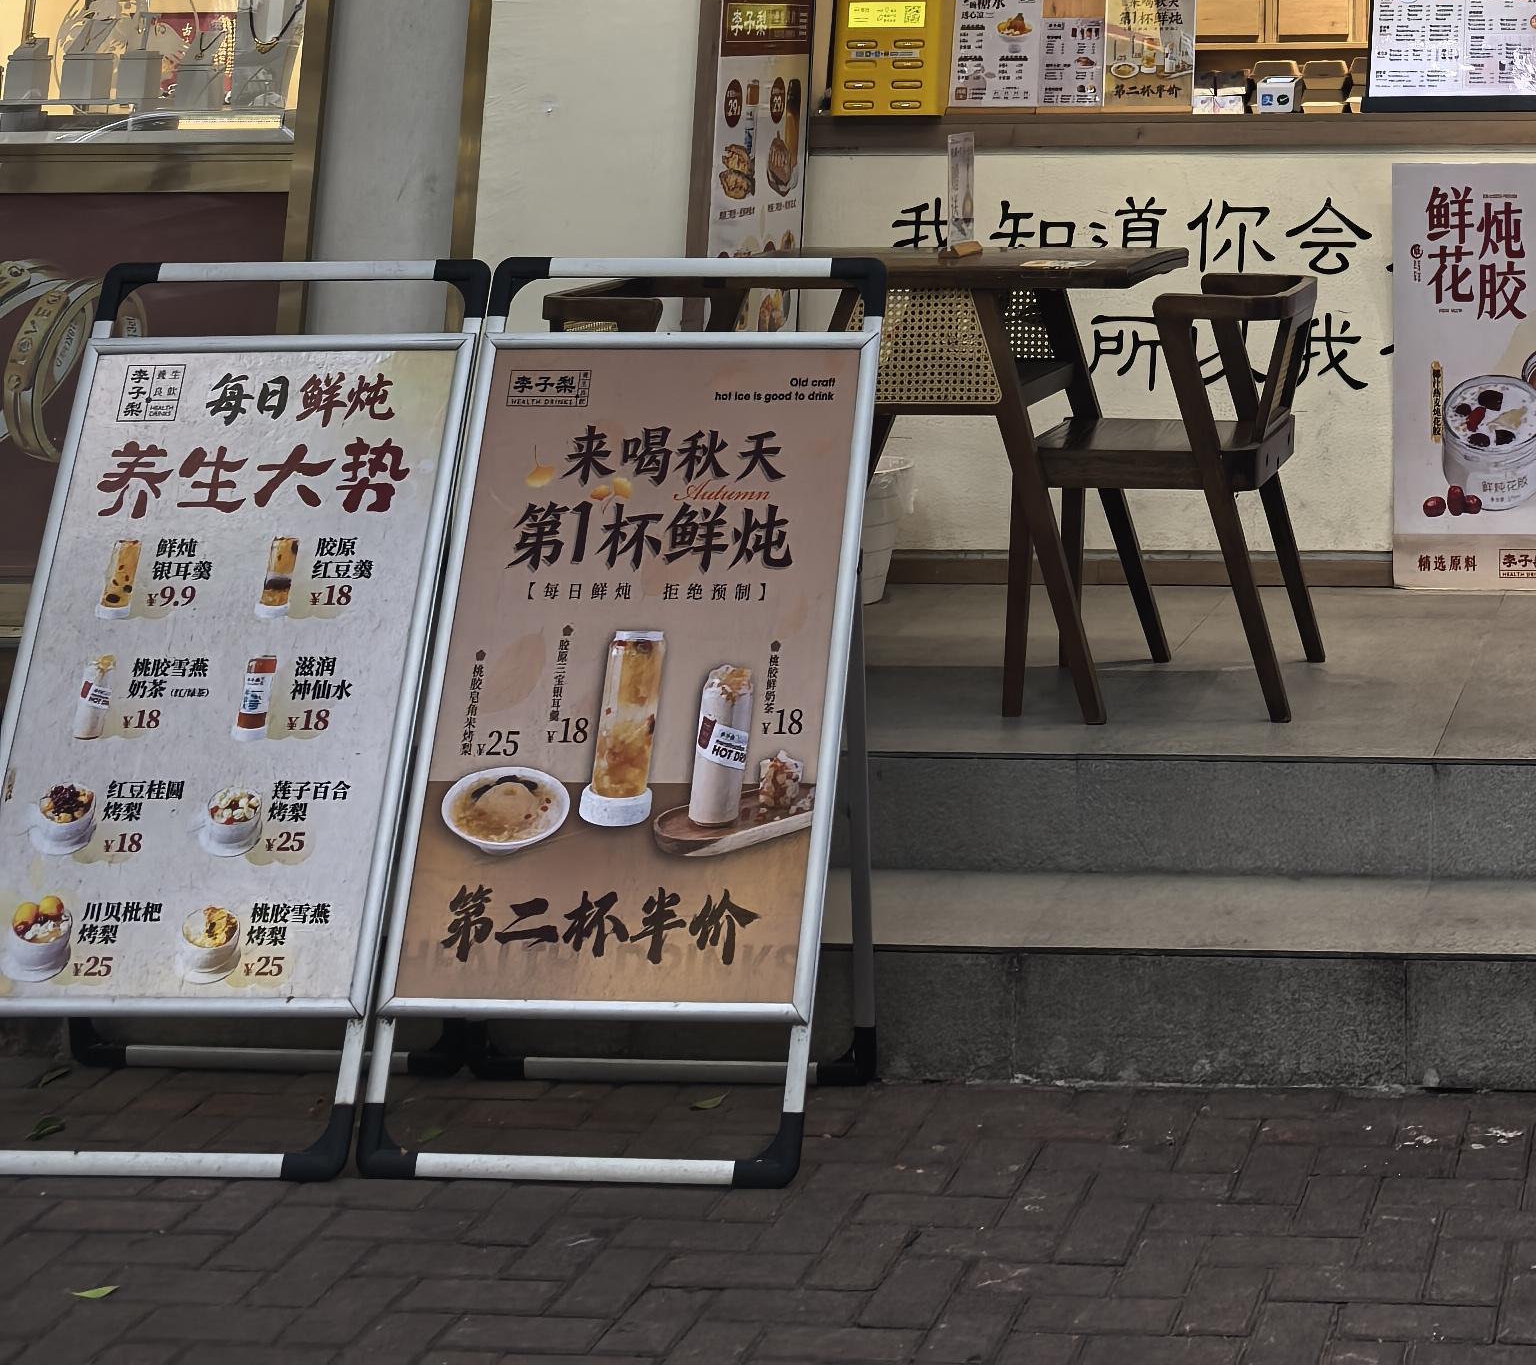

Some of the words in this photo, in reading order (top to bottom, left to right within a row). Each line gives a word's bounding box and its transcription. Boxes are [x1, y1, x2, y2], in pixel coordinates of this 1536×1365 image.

[730, 9, 767, 36] 李子梨
[892, 197, 1393, 274] 我知道你会
[123, 369, 149, 416] 李子梨
[513, 375, 576, 394] 李子梨
[790, 377, 808, 387] Old
[811, 377, 835, 387] craft
[205, 371, 396, 428] 每日鲜炖
[714, 391, 731, 400] hot
[753, 391, 762, 400] is
[764, 391, 792, 403] good
[795, 391, 805, 400] to
[808, 391, 834, 400] drink
[559, 425, 786, 487] 来喝秋天
[97, 436, 411, 519] 养生大势
[673, 480, 771, 503] Autumn
[155, 538, 198, 558] 鲜炖
[315, 537, 358, 557] 胶原
[505, 500, 794, 575] 第1杯鲜炖
[151, 559, 213, 581] 银耳羹
[311, 559, 373, 581] 红豆羹
[1417, 554, 1478, 572] 精选原料
[146, 585, 196, 608] ¥9.9
[310, 584, 353, 607] ¥18
[131, 657, 209, 678] 桃胶雪燕
[294, 656, 337, 677] 滋润
[127, 679, 167, 699] 奶茶
[289, 679, 354, 701] 神仙水
[122, 709, 161, 729] ¥18
[286, 708, 330, 731] ¥18
[761, 708, 803, 735] ¥18
[547, 717, 589, 744] ¥18
[476, 730, 521, 756] ¥25
[711, 745, 732, 760] HOT
[271, 780, 352, 801] 莲子百合
[101, 802, 142, 822] 烤梨
[267, 802, 308, 822] 烤梨
[103, 832, 143, 853] ¥18
[265, 831, 306, 852] ¥25
[82, 901, 163, 923] 川贝枇杷
[250, 902, 331, 924] 桃胶雪燕
[77, 924, 119, 945] 烤梨
[245, 925, 287, 947] 烤梨
[441, 884, 761, 966] 第二杯半价
[72, 955, 114, 977] ¥25
[243, 955, 285, 977] ¥25
